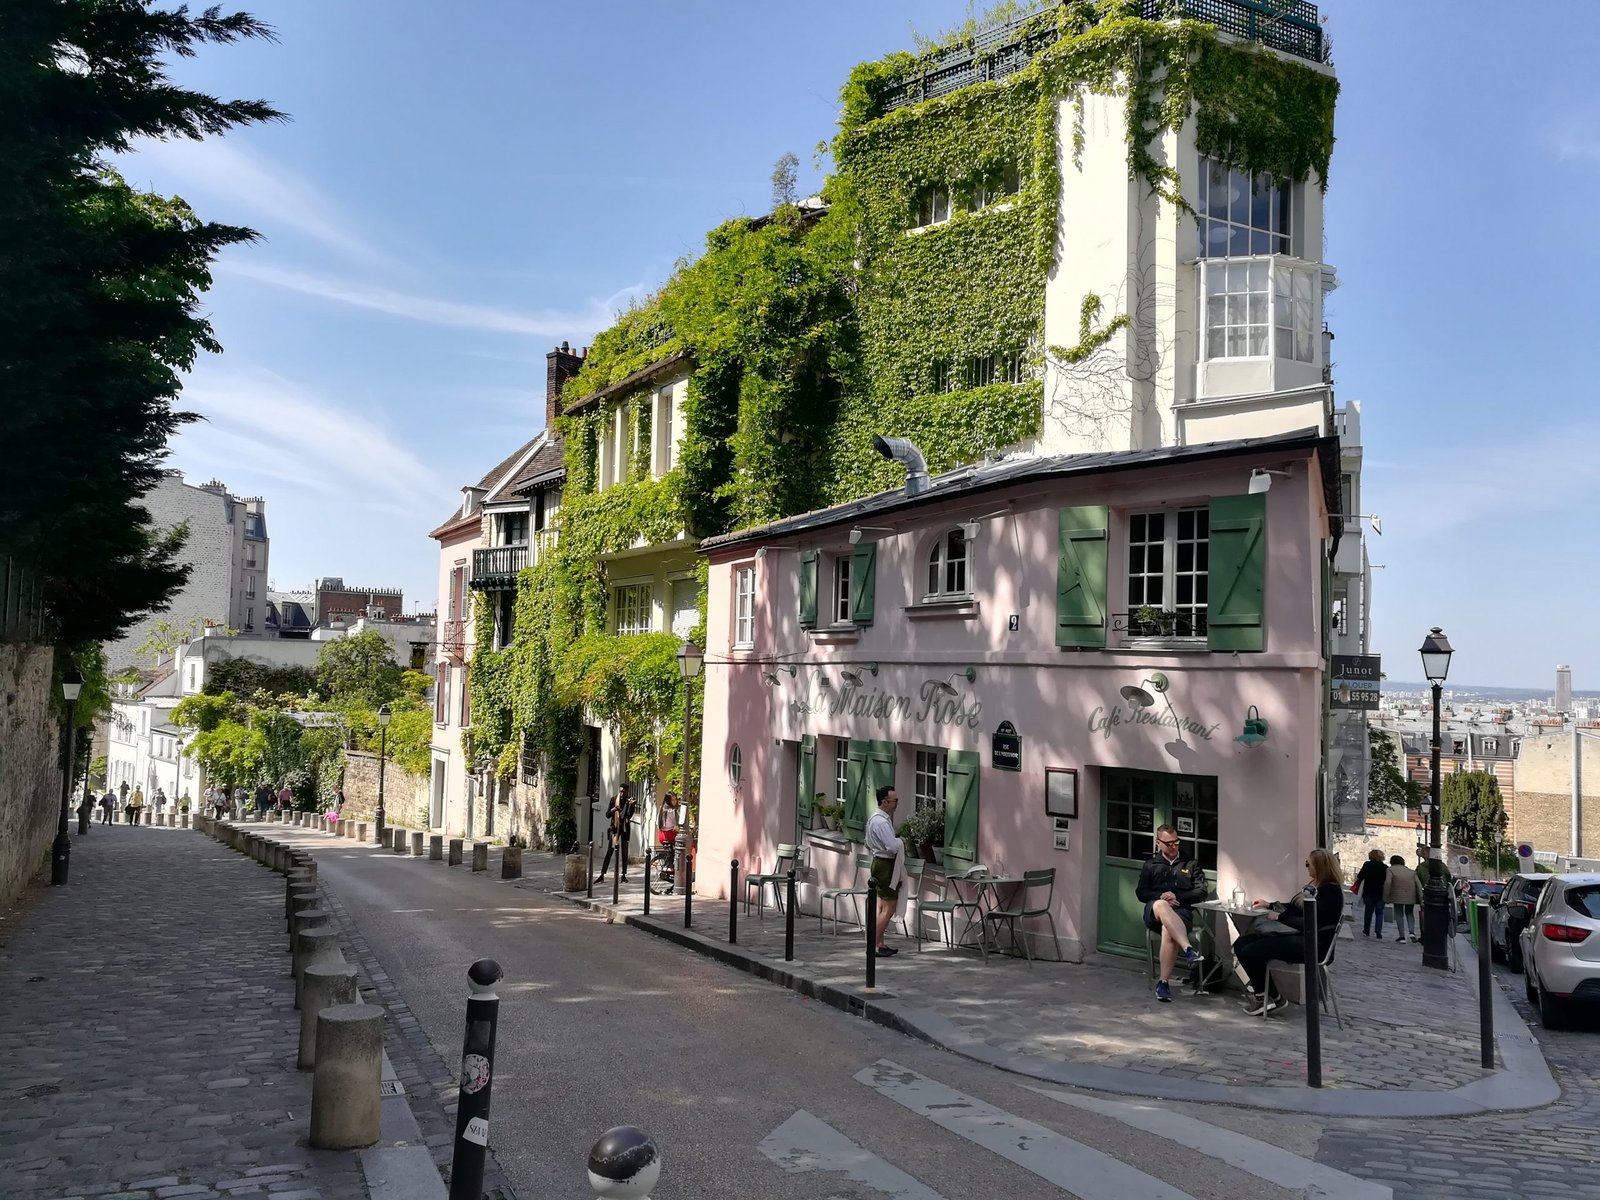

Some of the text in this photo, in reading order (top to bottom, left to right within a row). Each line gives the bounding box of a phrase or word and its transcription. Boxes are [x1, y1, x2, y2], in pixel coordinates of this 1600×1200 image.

[1340, 664, 1372, 676] Junot
[799, 669, 982, 729] La Maison Rose
[1351, 692, 1360, 701] 55
[1087, 703, 1221, 741] Café Restaurant
